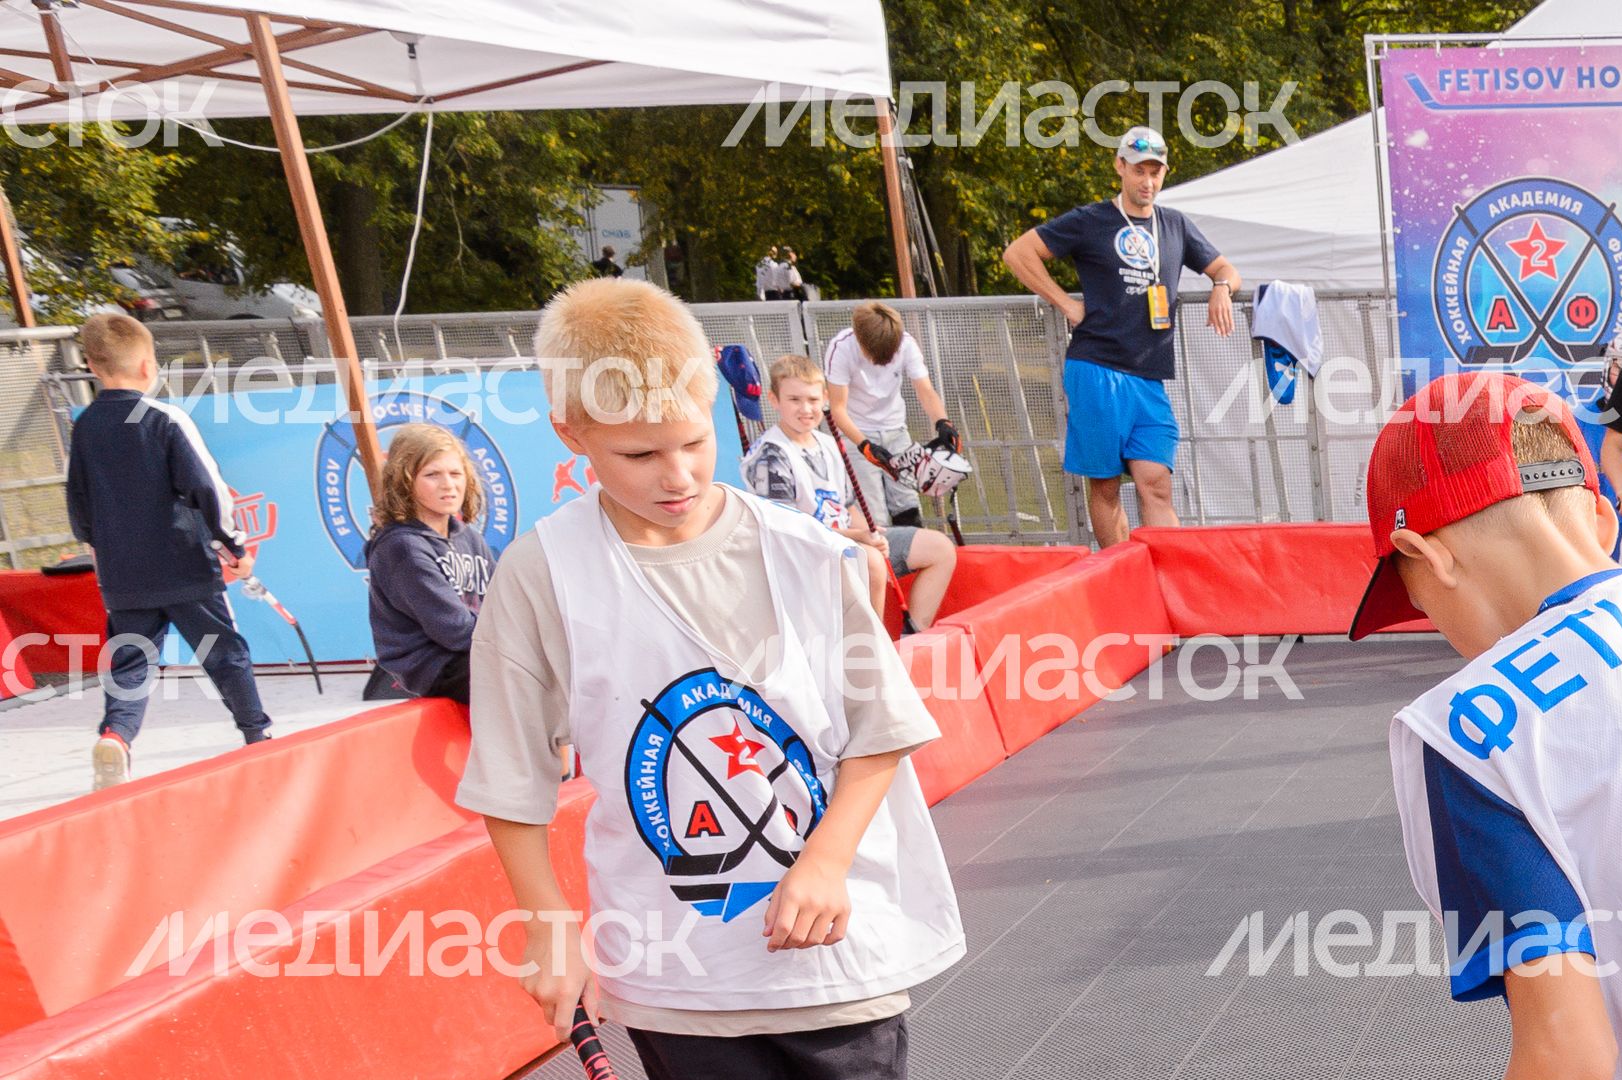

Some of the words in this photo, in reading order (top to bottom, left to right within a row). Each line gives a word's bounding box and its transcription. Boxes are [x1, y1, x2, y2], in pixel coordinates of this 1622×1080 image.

[1438, 66, 1566, 92] FETISOV
[1487, 190, 1583, 218] АКАДЕМИЯ
[1529, 239, 1549, 268] 2
[1442, 236, 1472, 345] ХОККЕЙНАЯ
[1486, 297, 1518, 330] А
[1566, 294, 1598, 330] Ф
[326, 458, 351, 537] FETISOV
[373, 401, 437, 420] OCKEY
[473, 447, 509, 536] ACADEMY
[680, 683, 773, 728] АКАДМИЯ
[684, 800, 726, 838] А
